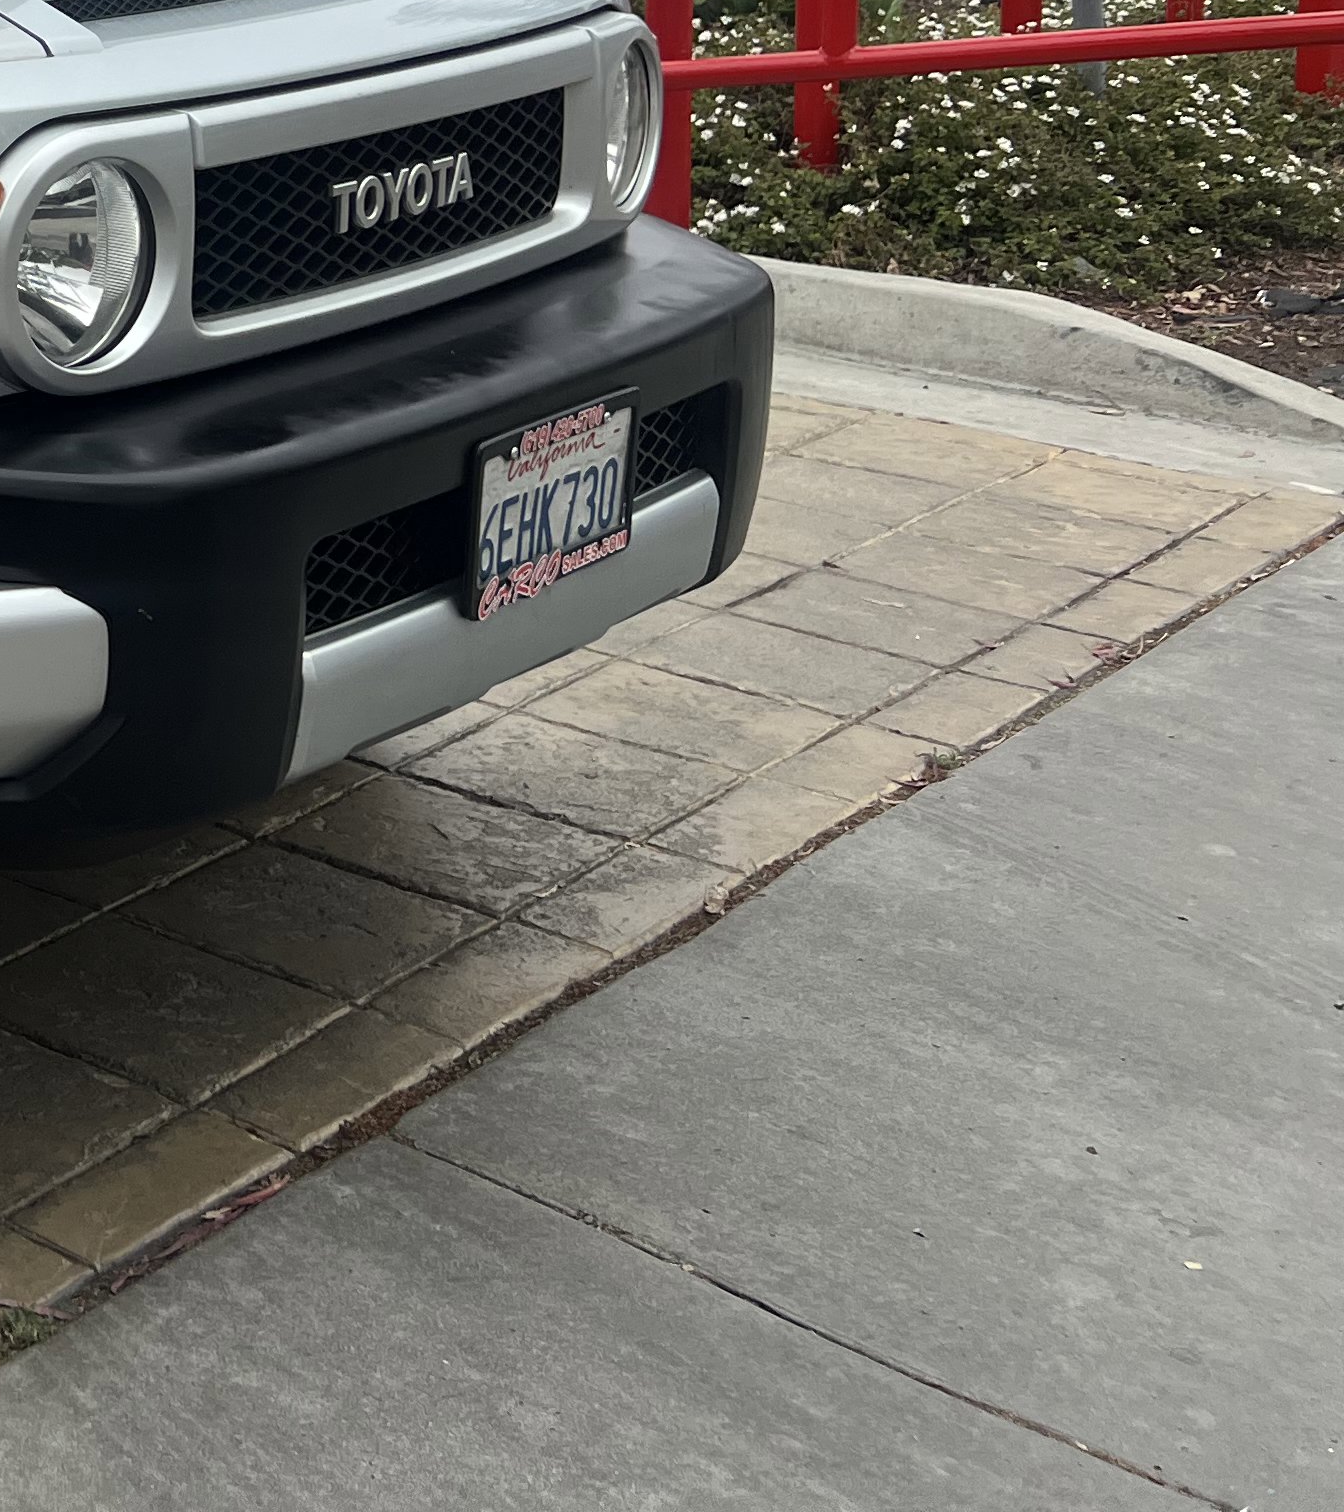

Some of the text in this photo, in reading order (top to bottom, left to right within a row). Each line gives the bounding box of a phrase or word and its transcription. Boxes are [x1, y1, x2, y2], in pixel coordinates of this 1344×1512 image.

[332, 152, 474, 234] TOYOTA
[508, 432, 605, 482] California
[478, 457, 618, 582] 6EHK730
[562, 529, 628, 574] SALES.COM
